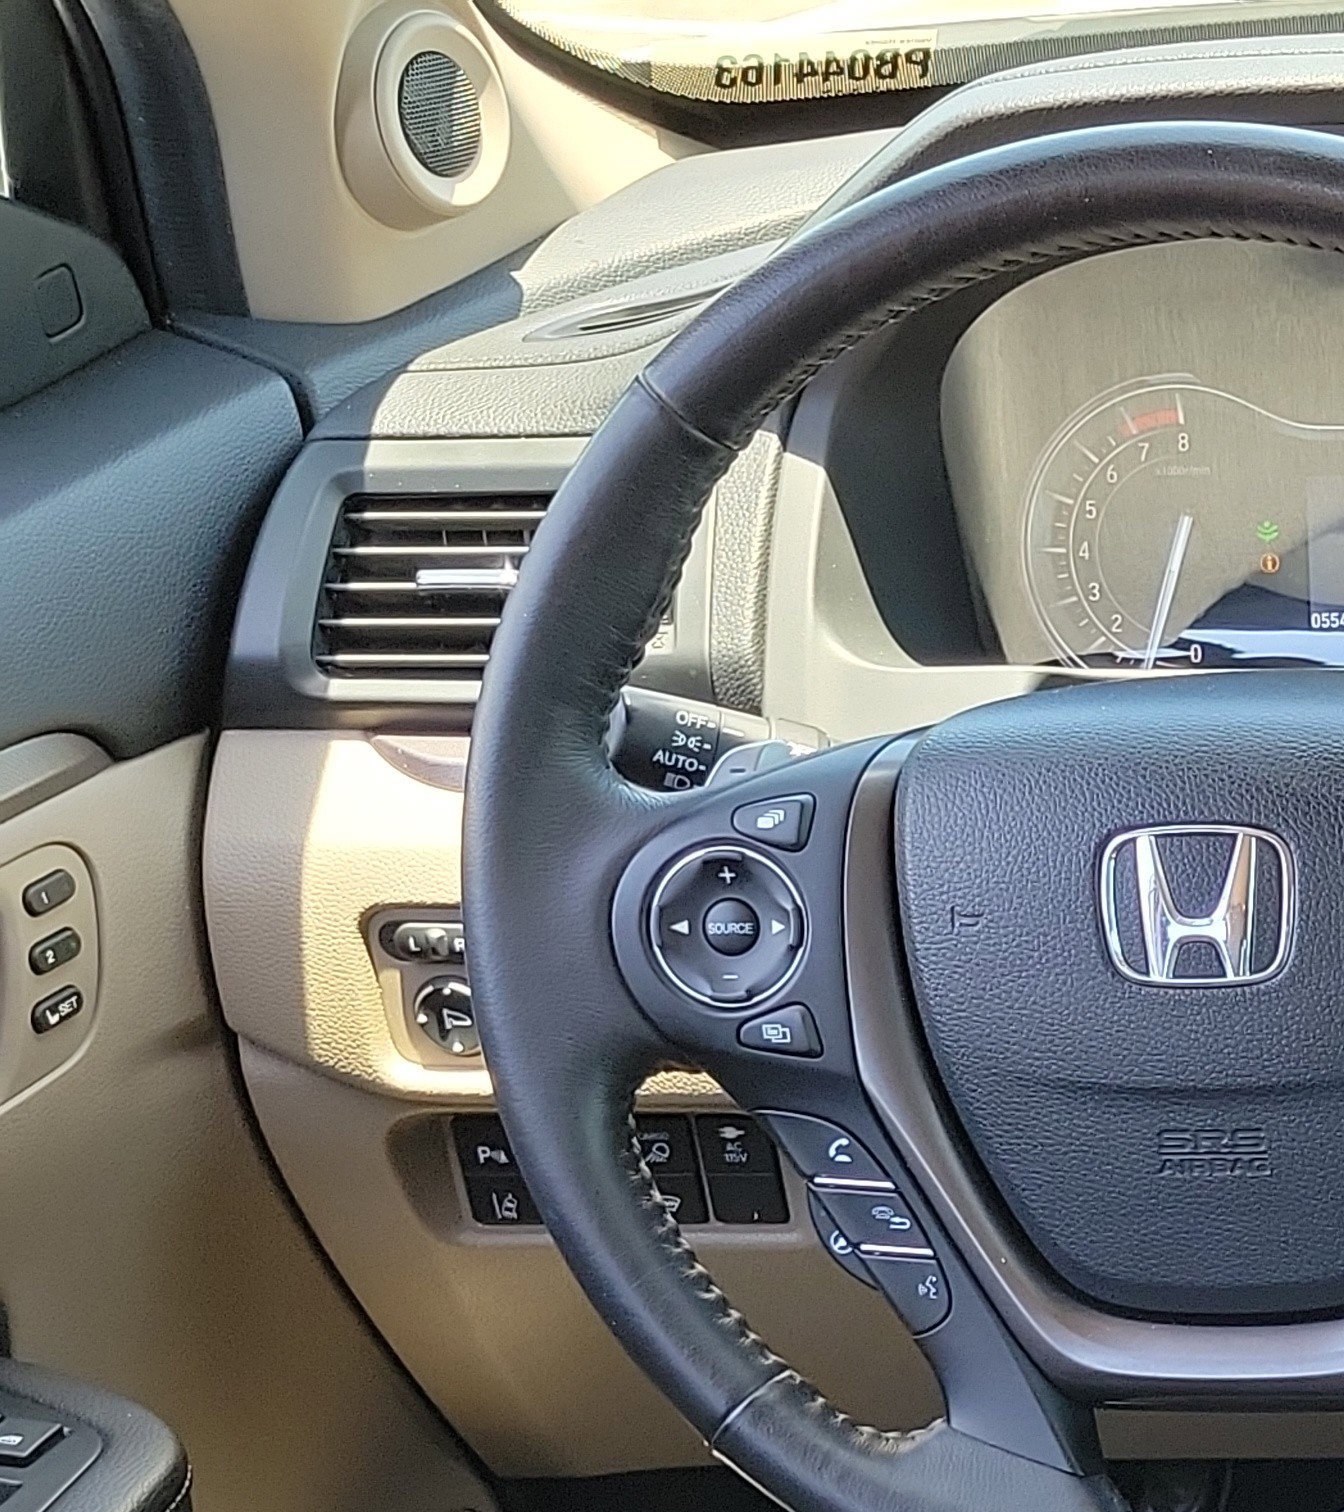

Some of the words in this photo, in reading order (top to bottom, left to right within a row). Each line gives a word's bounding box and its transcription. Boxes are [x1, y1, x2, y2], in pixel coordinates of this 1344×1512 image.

[1177, 433, 1190, 451] 8
[1138, 443, 1149, 461] 7
[1106, 465, 1118, 483] 6
[1085, 501, 1097, 519] 5
[1078, 540, 1090, 560] 4
[1088, 583, 1100, 601] 3
[1110, 615, 1123, 633] 2
[1190, 643, 1202, 663] 0
[676, 710, 708, 729] OFF
[652, 749, 699, 772] AUTO
[707, 921, 755, 935] SOURCE
[408, 935, 422, 952] L
[45, 950, 56, 965] 2
